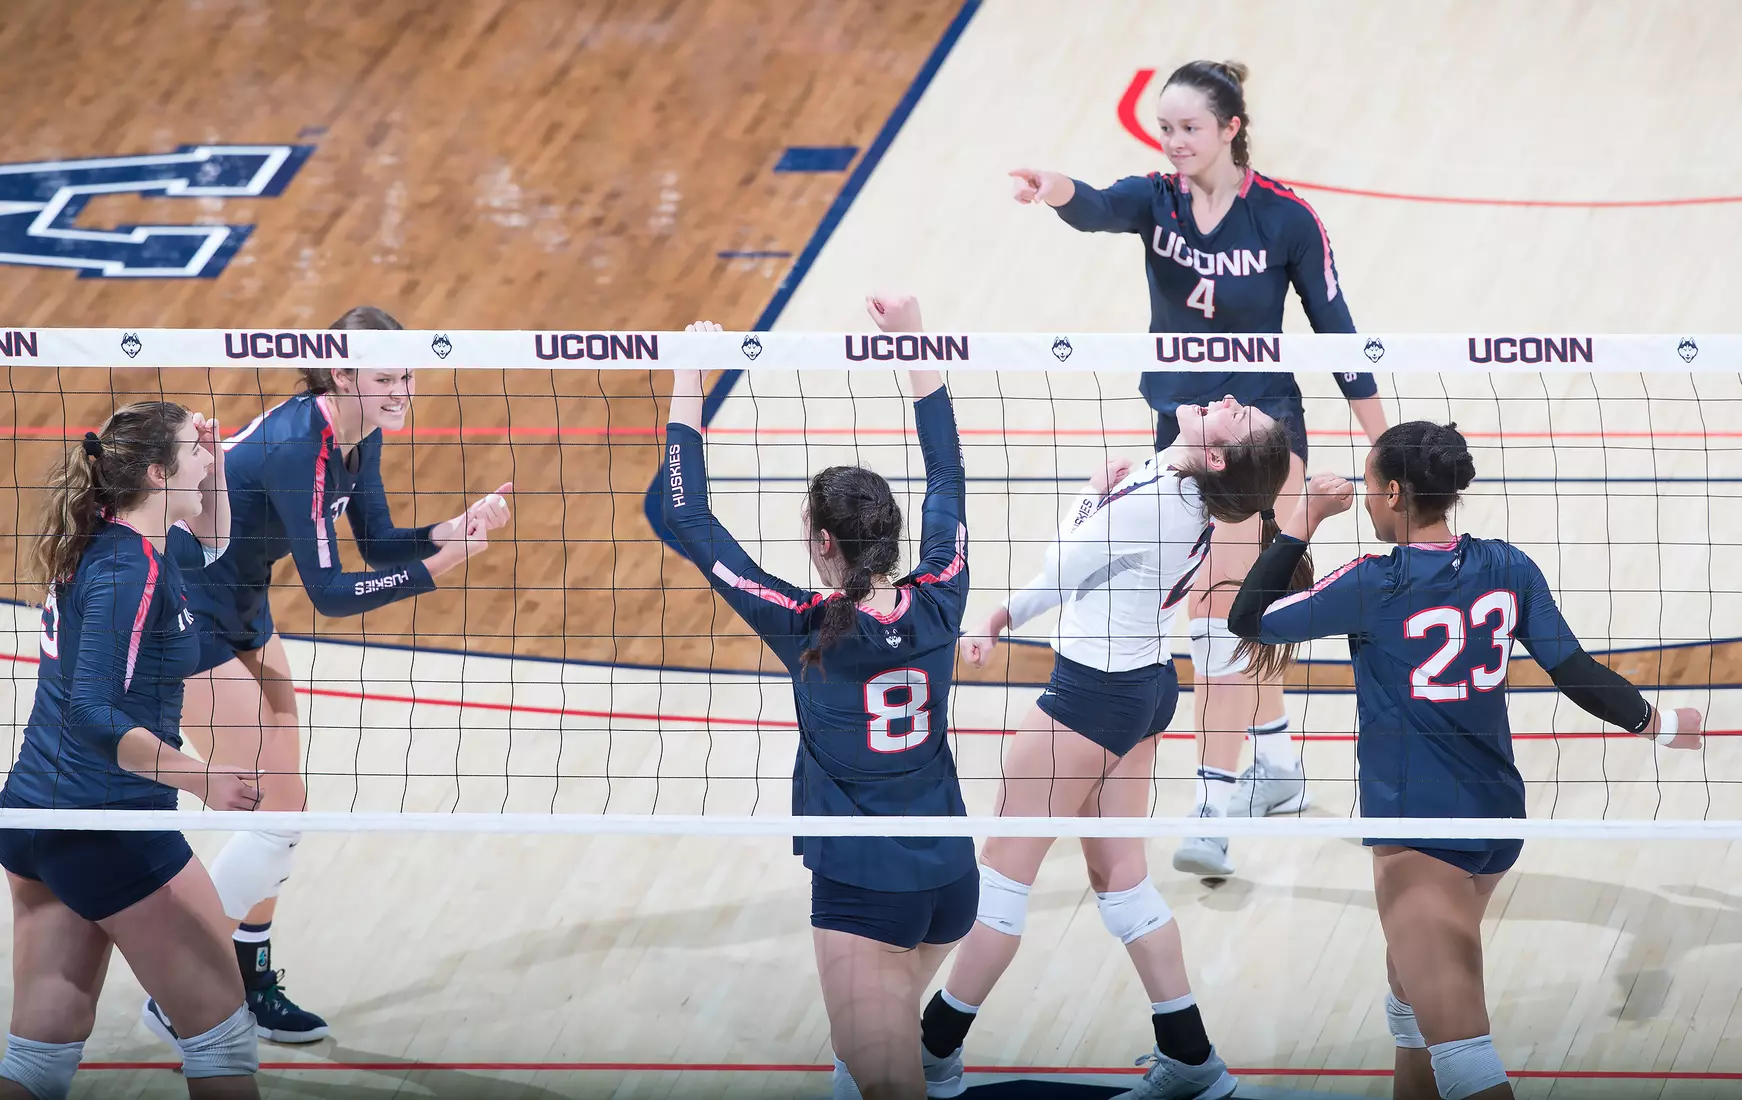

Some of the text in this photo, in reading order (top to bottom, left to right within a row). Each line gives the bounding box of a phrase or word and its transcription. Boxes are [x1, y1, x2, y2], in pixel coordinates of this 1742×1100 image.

[1152, 224, 1268, 276] UCONN
[1186, 277, 1215, 319] 4
[225, 333, 348, 358] UCONN
[535, 334, 658, 360] UCONN
[846, 335, 969, 361] UCONN
[1156, 336, 1280, 362] UCONN
[1468, 337, 1593, 363] UCONN
[669, 444, 686, 508] HUSKIES
[1403, 589, 1519, 702] 23
[863, 667, 931, 754] 8
